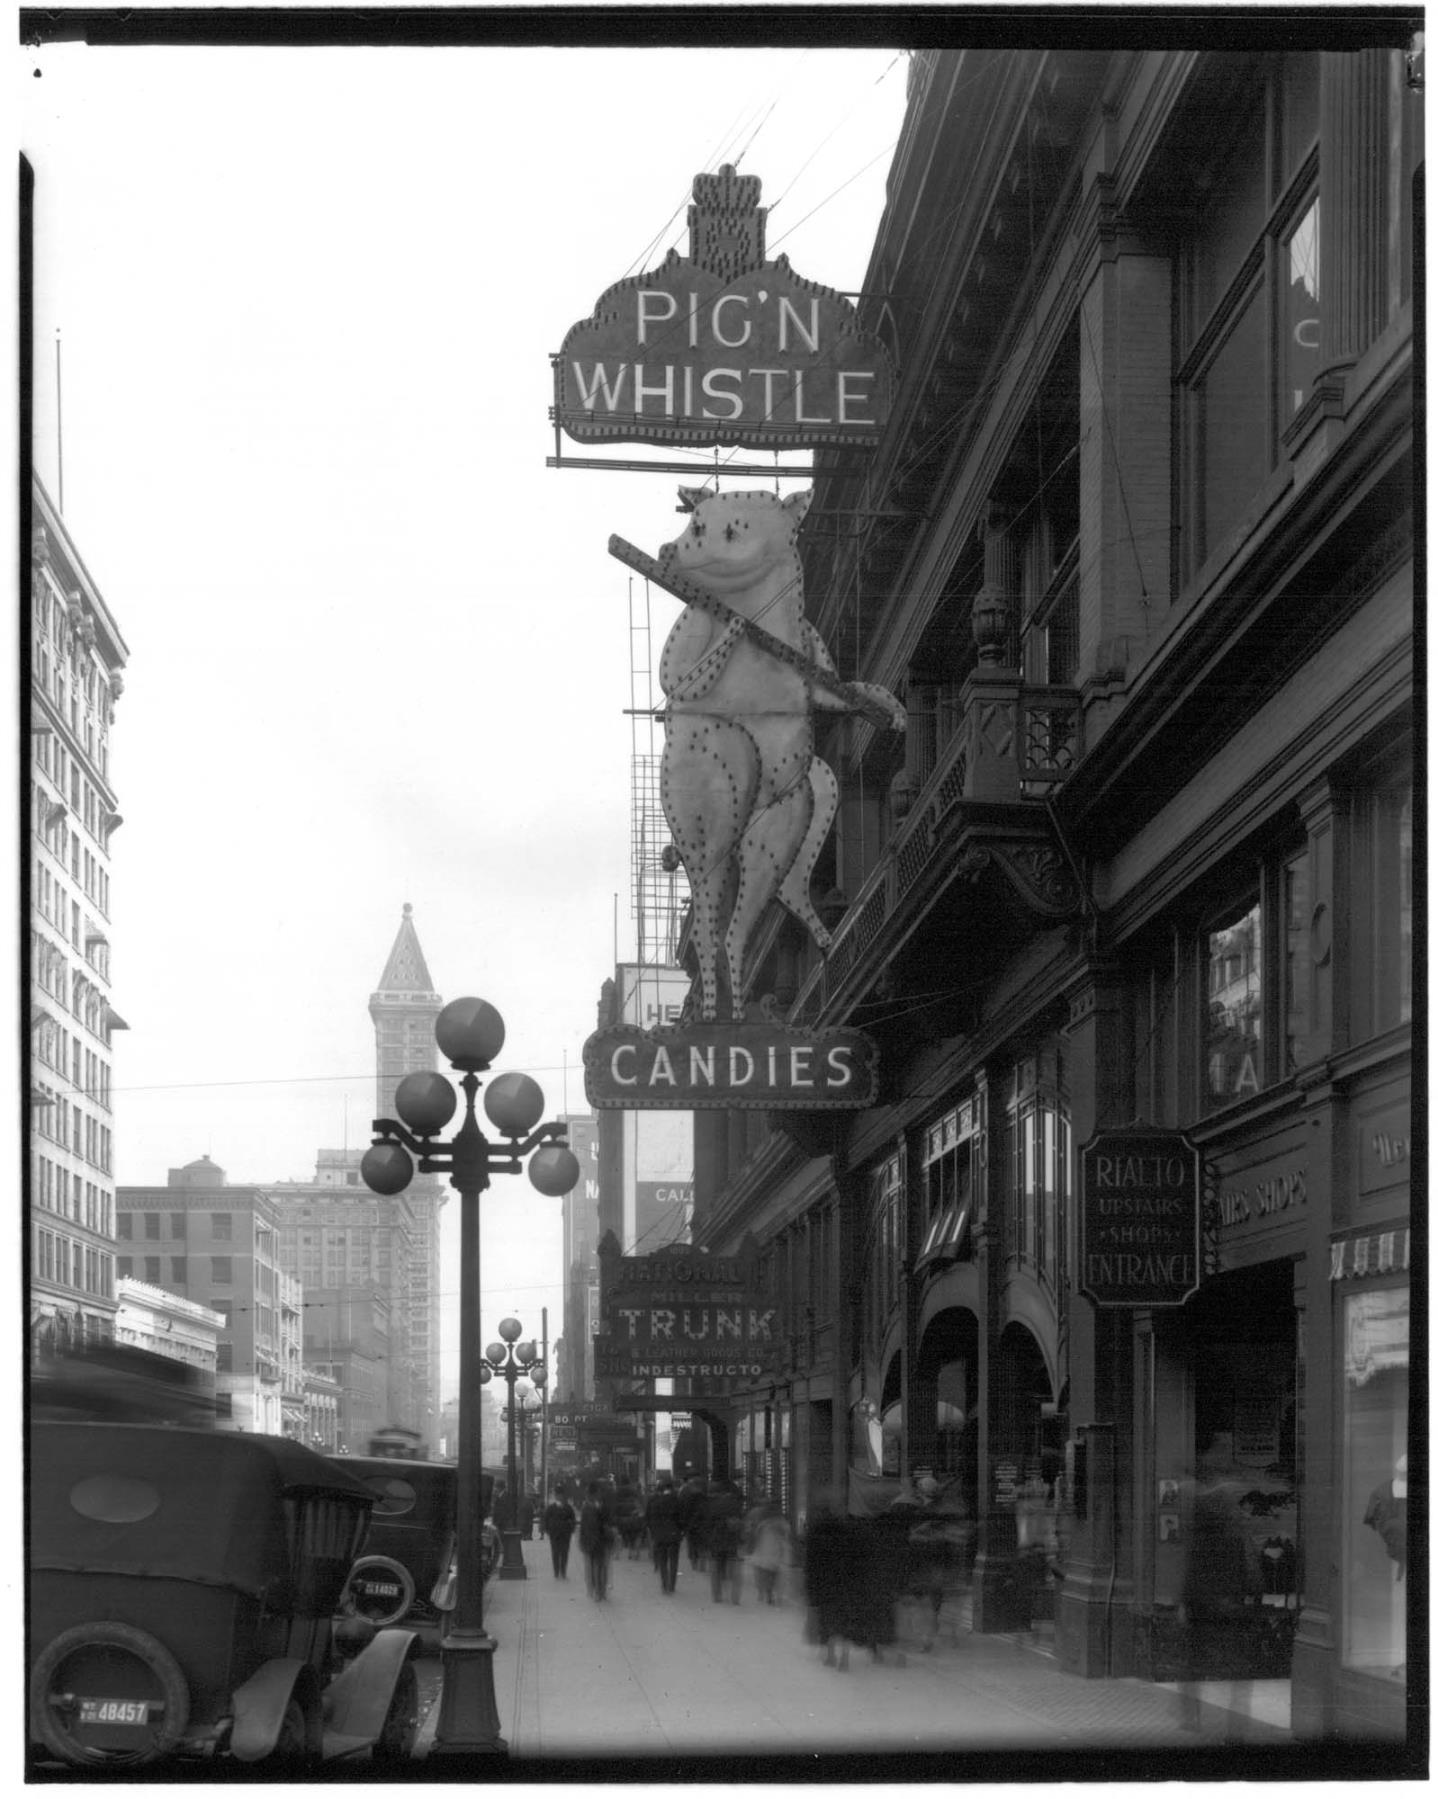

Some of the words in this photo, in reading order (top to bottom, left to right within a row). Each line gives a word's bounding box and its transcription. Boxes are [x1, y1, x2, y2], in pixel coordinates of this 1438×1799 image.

[637, 290, 819, 352] PIG'N
[573, 361, 875, 425] WHISTLE
[611, 1045, 852, 1087] CANDIES
[1096, 1156, 1185, 1187] RIALTO
[1099, 1198, 1183, 1215] UPSTAIRS
[1256, 1169, 1307, 1216] SHOPS
[1087, 1253, 1195, 1285] ENTRANCE
[618, 1309, 776, 1340] TRUNK
[632, 1364, 762, 1376] INDESTRUCTO
[98, 1702, 146, 1721] 48457
